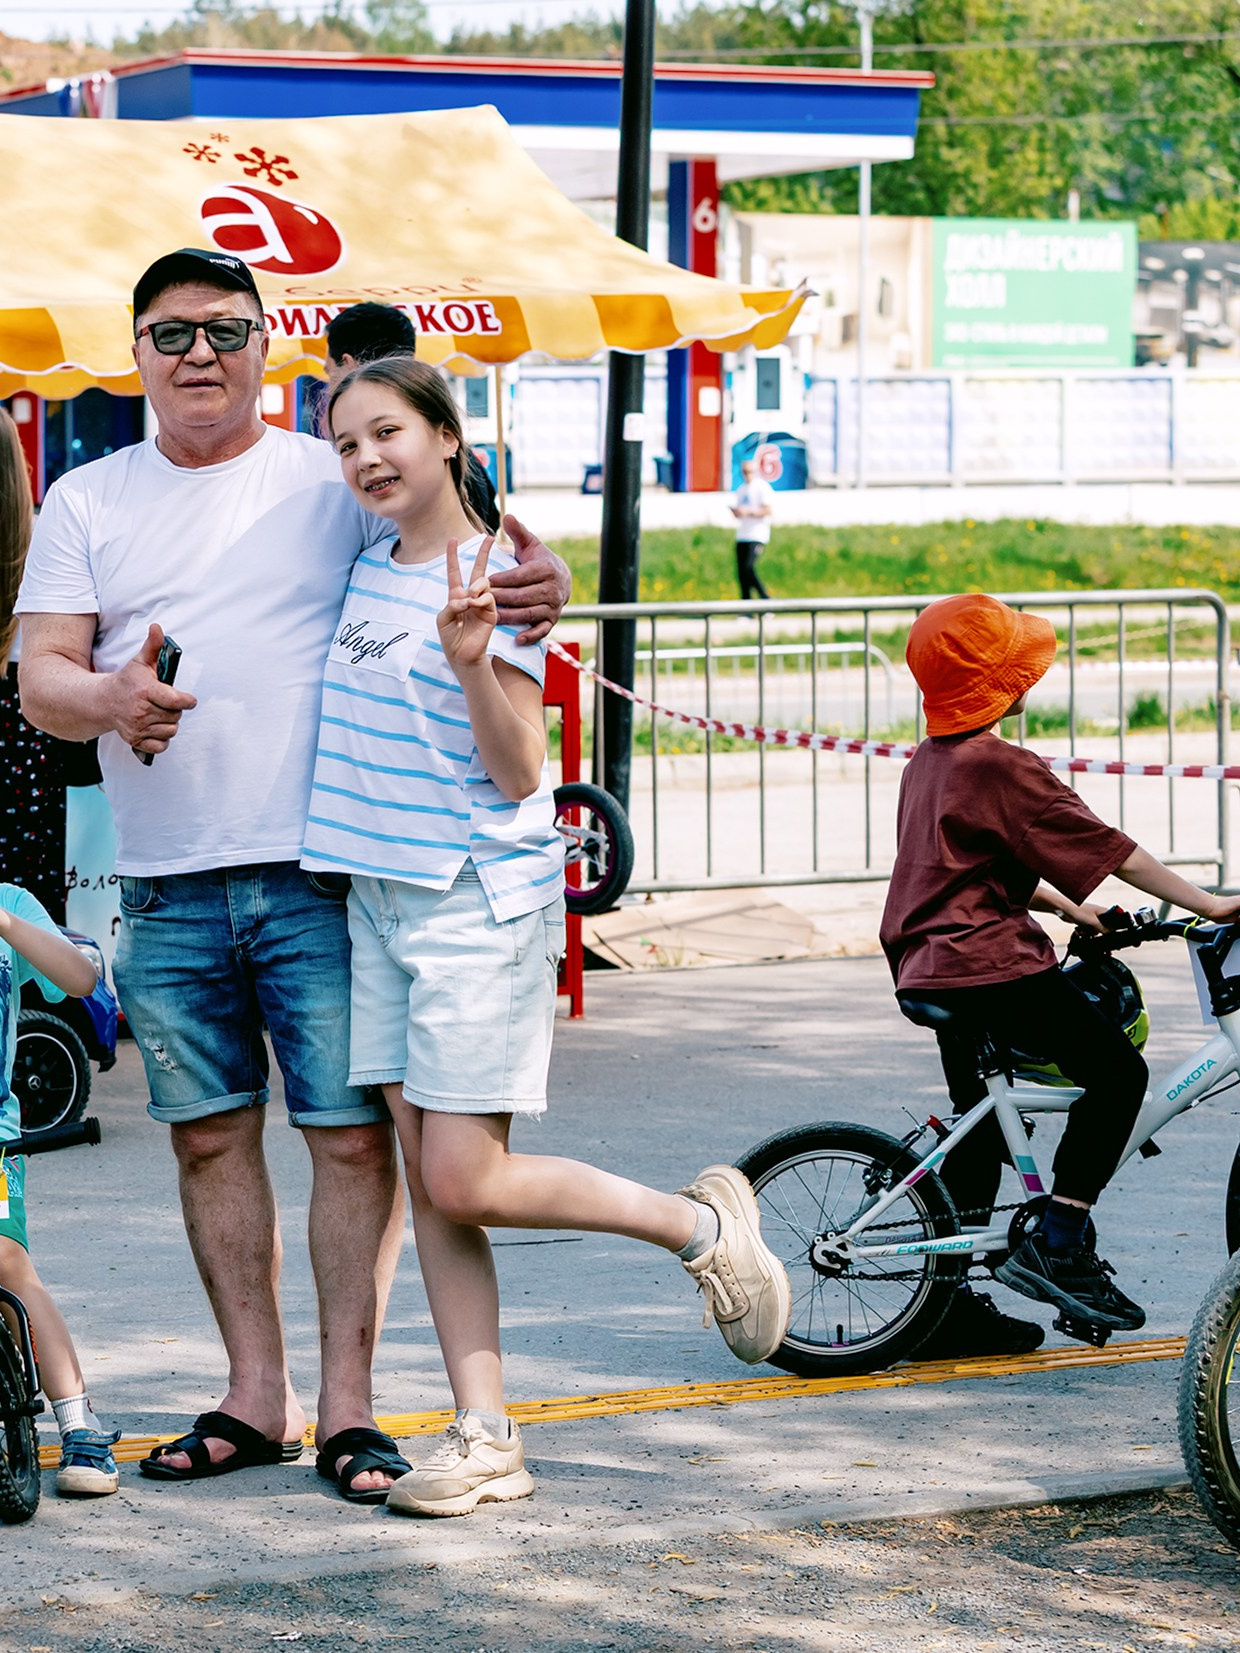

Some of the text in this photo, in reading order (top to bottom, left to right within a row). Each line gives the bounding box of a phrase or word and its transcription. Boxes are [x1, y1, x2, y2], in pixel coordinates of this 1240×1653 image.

[692, 197, 717, 233] 6
[333, 620, 409, 664] Angel
[1166, 1059, 1217, 1101] DAKOTA
[896, 1240, 974, 1254] FORWARD
